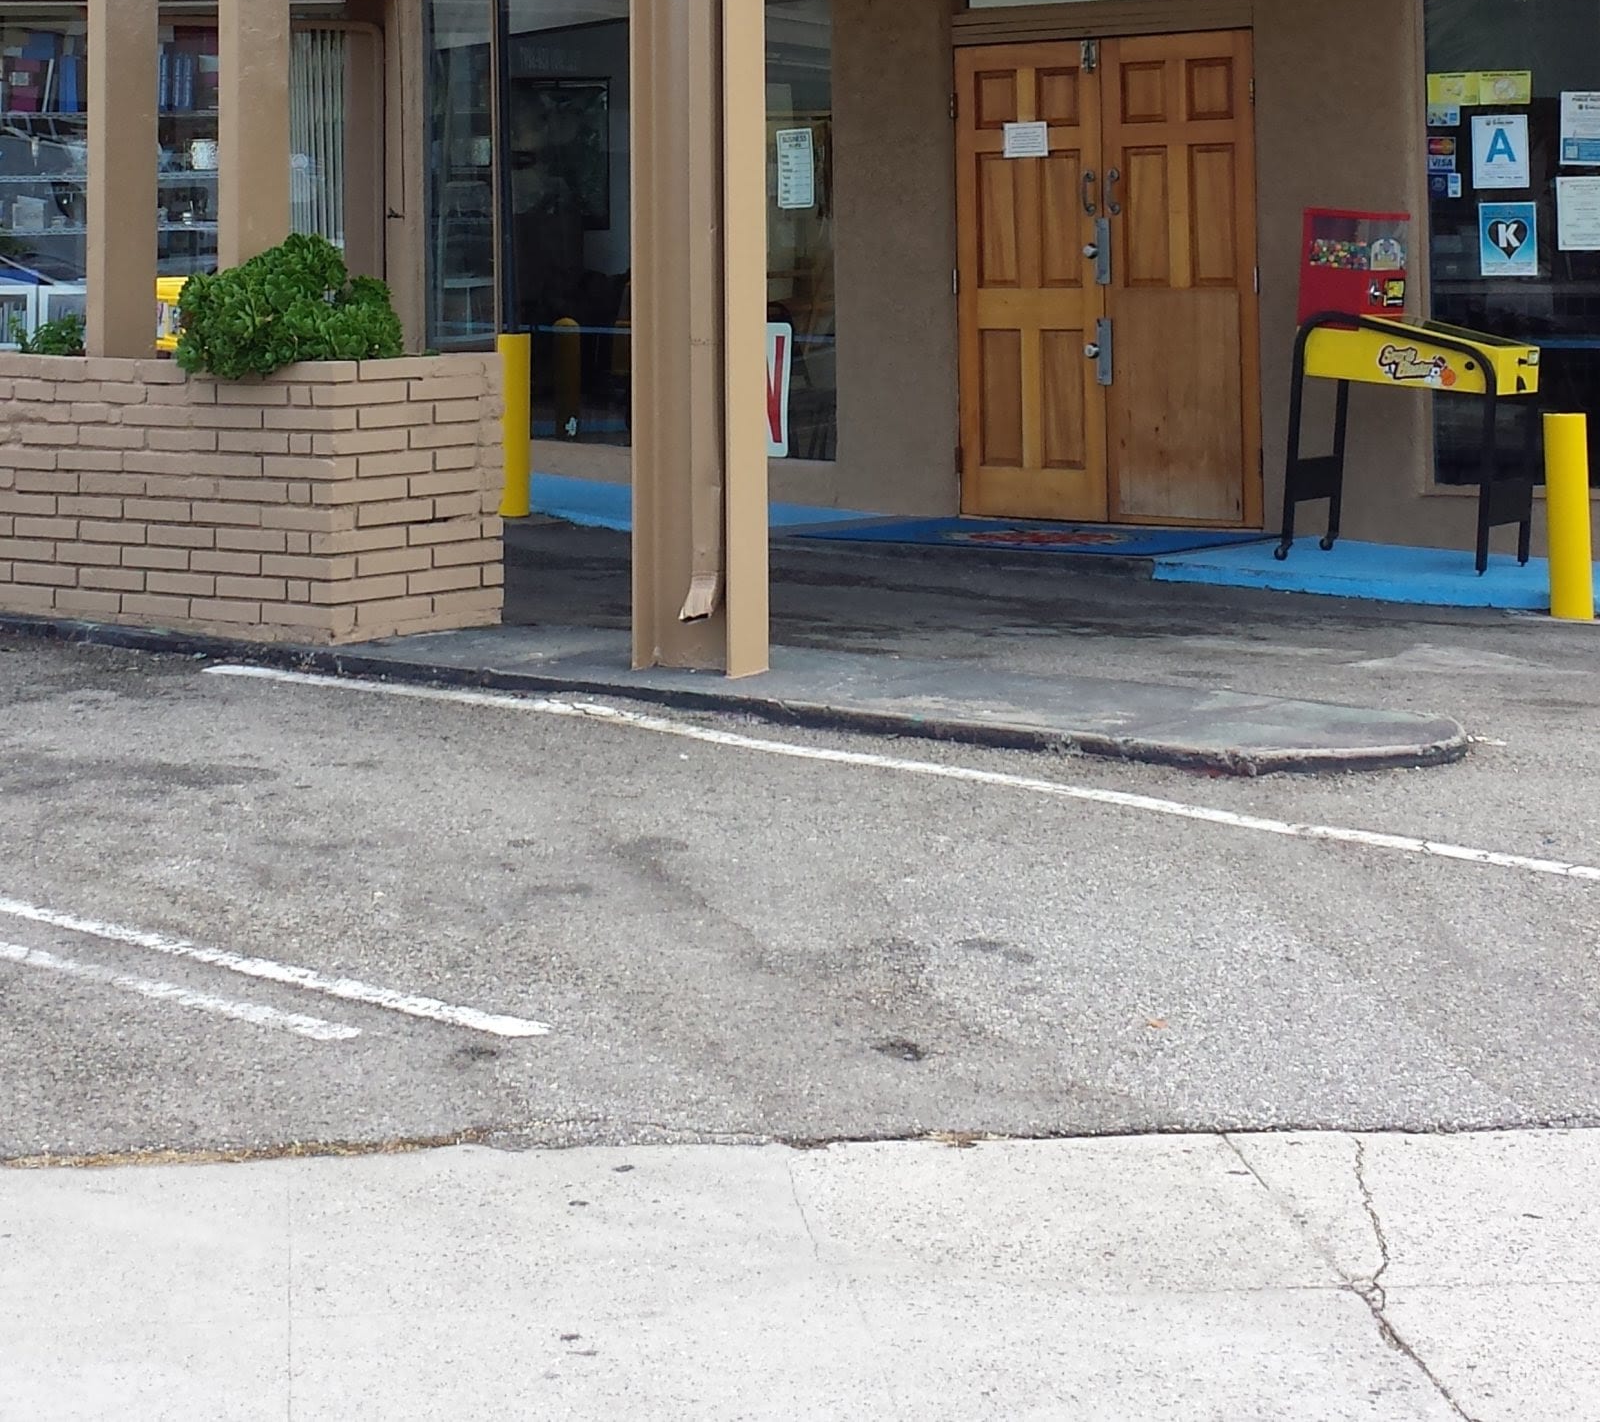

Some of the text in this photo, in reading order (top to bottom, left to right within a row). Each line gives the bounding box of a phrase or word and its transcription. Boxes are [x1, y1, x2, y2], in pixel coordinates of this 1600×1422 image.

[1486, 127, 1517, 163] A
[1431, 158, 1453, 167] VISA
[1497, 223, 1521, 247] K
